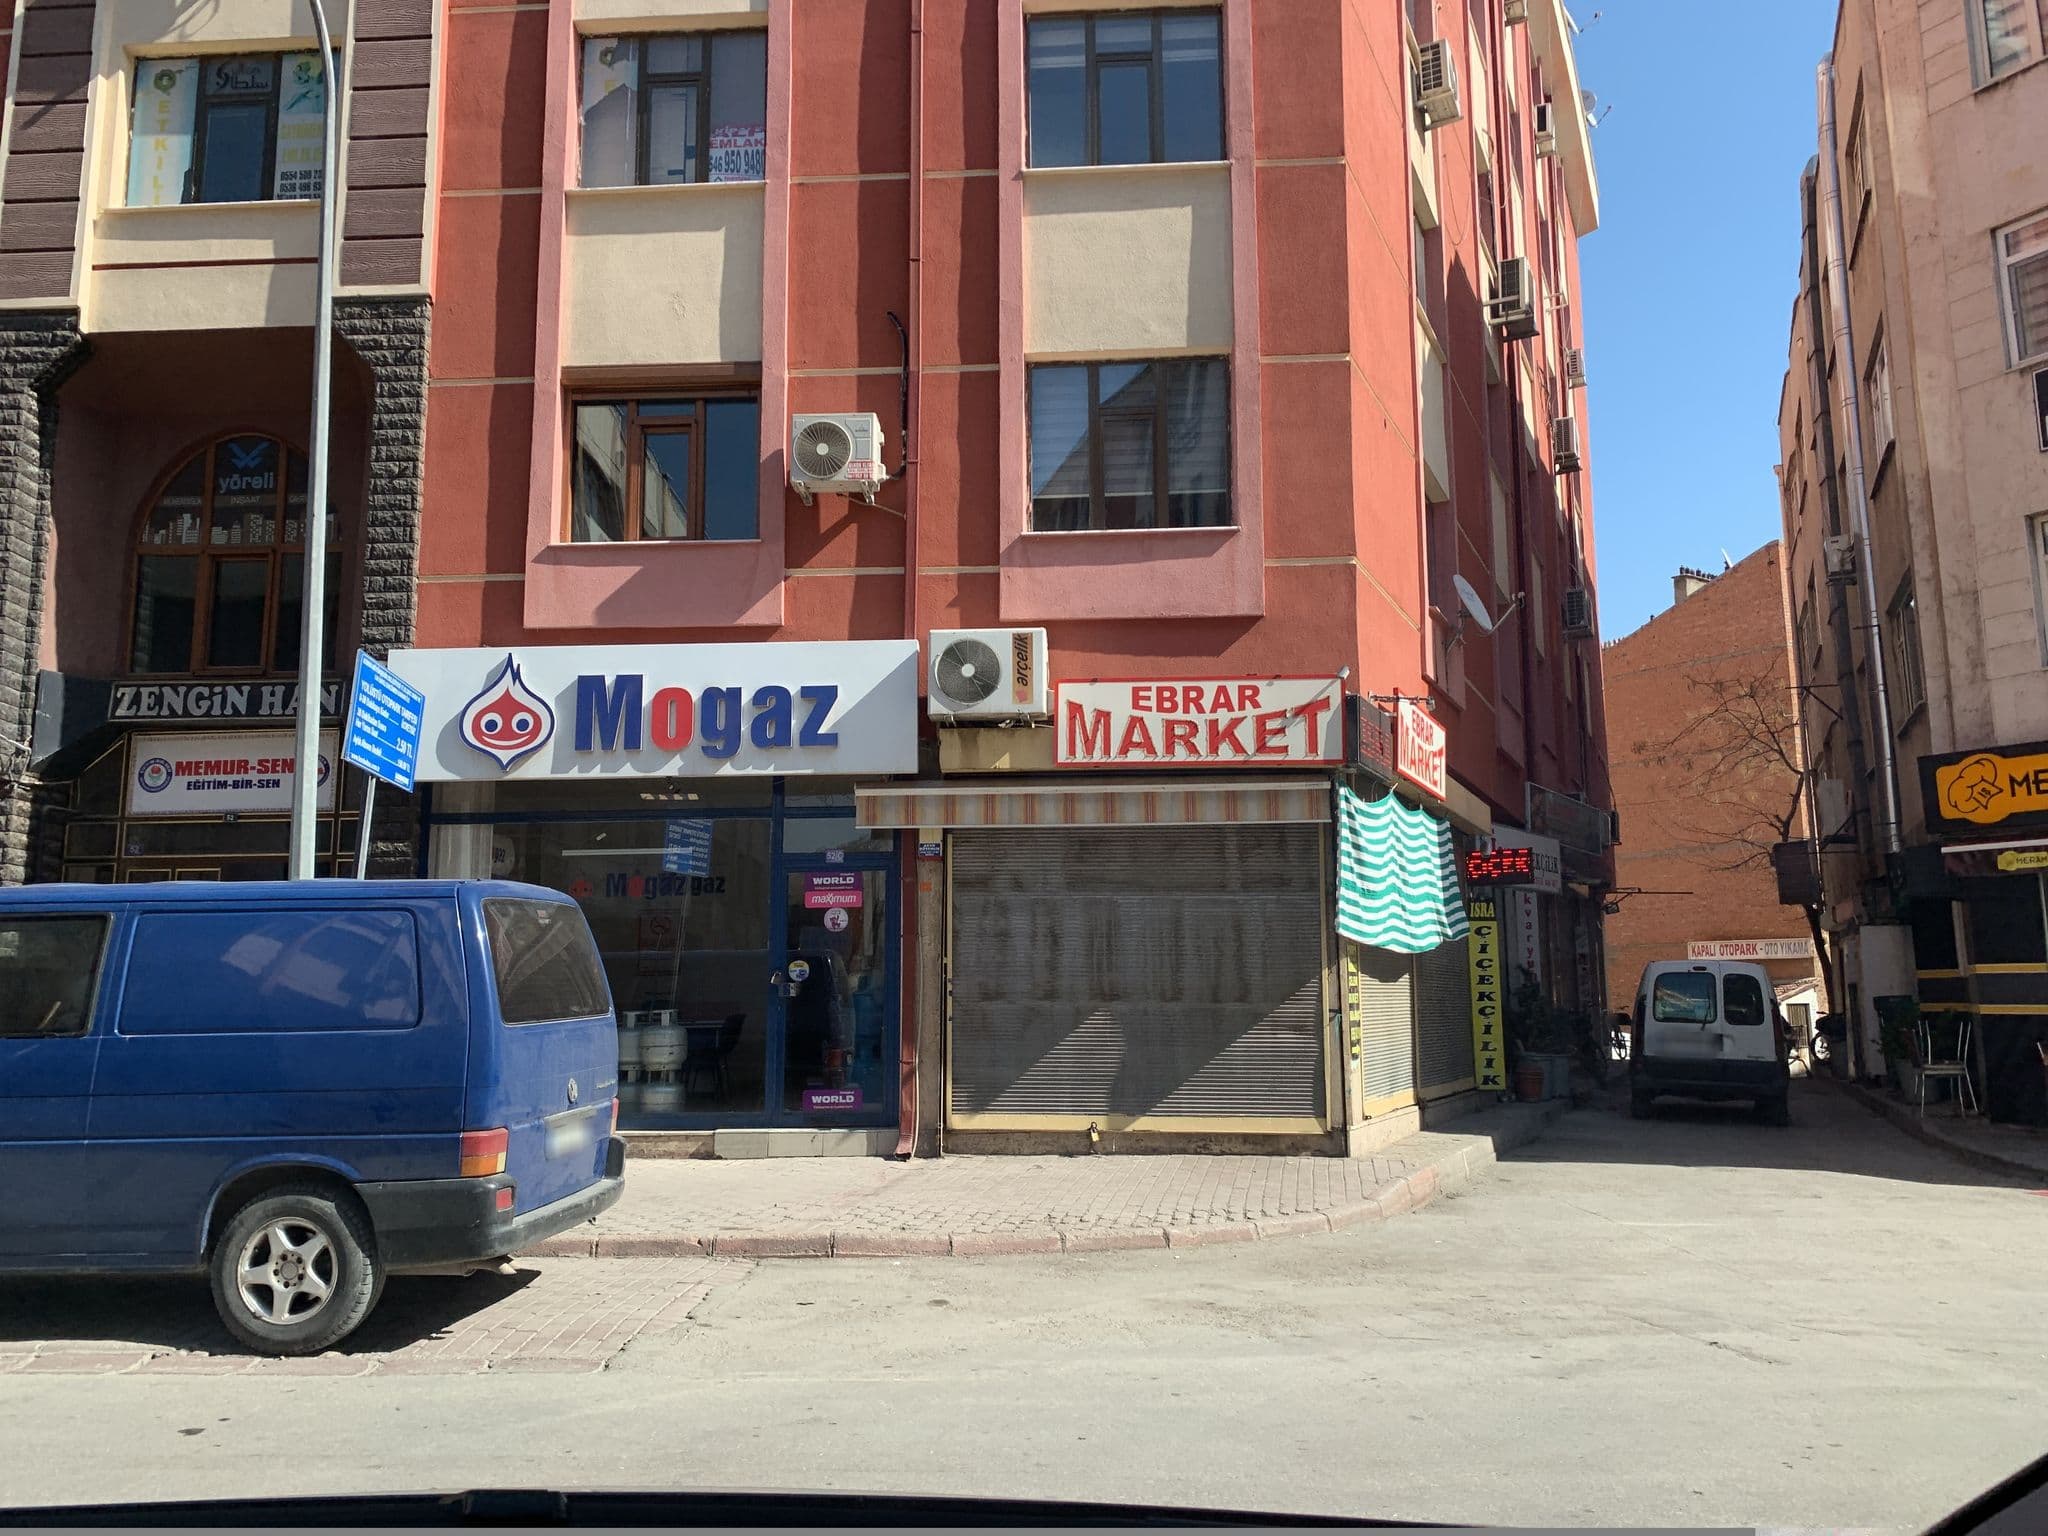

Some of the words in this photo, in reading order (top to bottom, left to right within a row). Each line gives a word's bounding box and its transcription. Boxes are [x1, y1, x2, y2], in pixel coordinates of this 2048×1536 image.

[724, 150, 741, 172] 950
[1016, 632, 1031, 687] arçelik
[1131, 684, 1261, 714] EBRAR
[575, 674, 839, 759] Mogaz
[1065, 697, 1331, 760] MARKET
[1411, 709, 1434, 747] EBRAR
[175, 758, 296, 777] MEMUR-SEN
[1400, 713, 1444, 795] MARKET
[186, 777, 280, 791] EĞİTİM-BİR-SEN
[1691, 944, 1716, 957] KAPALI
[1719, 943, 1758, 956] OTOPARK
[1765, 942, 1779, 955] OTO
[1475, 925, 1501, 1086] ÇİÇEKÇİLİK
[811, 1095, 854, 1103] WORLD
